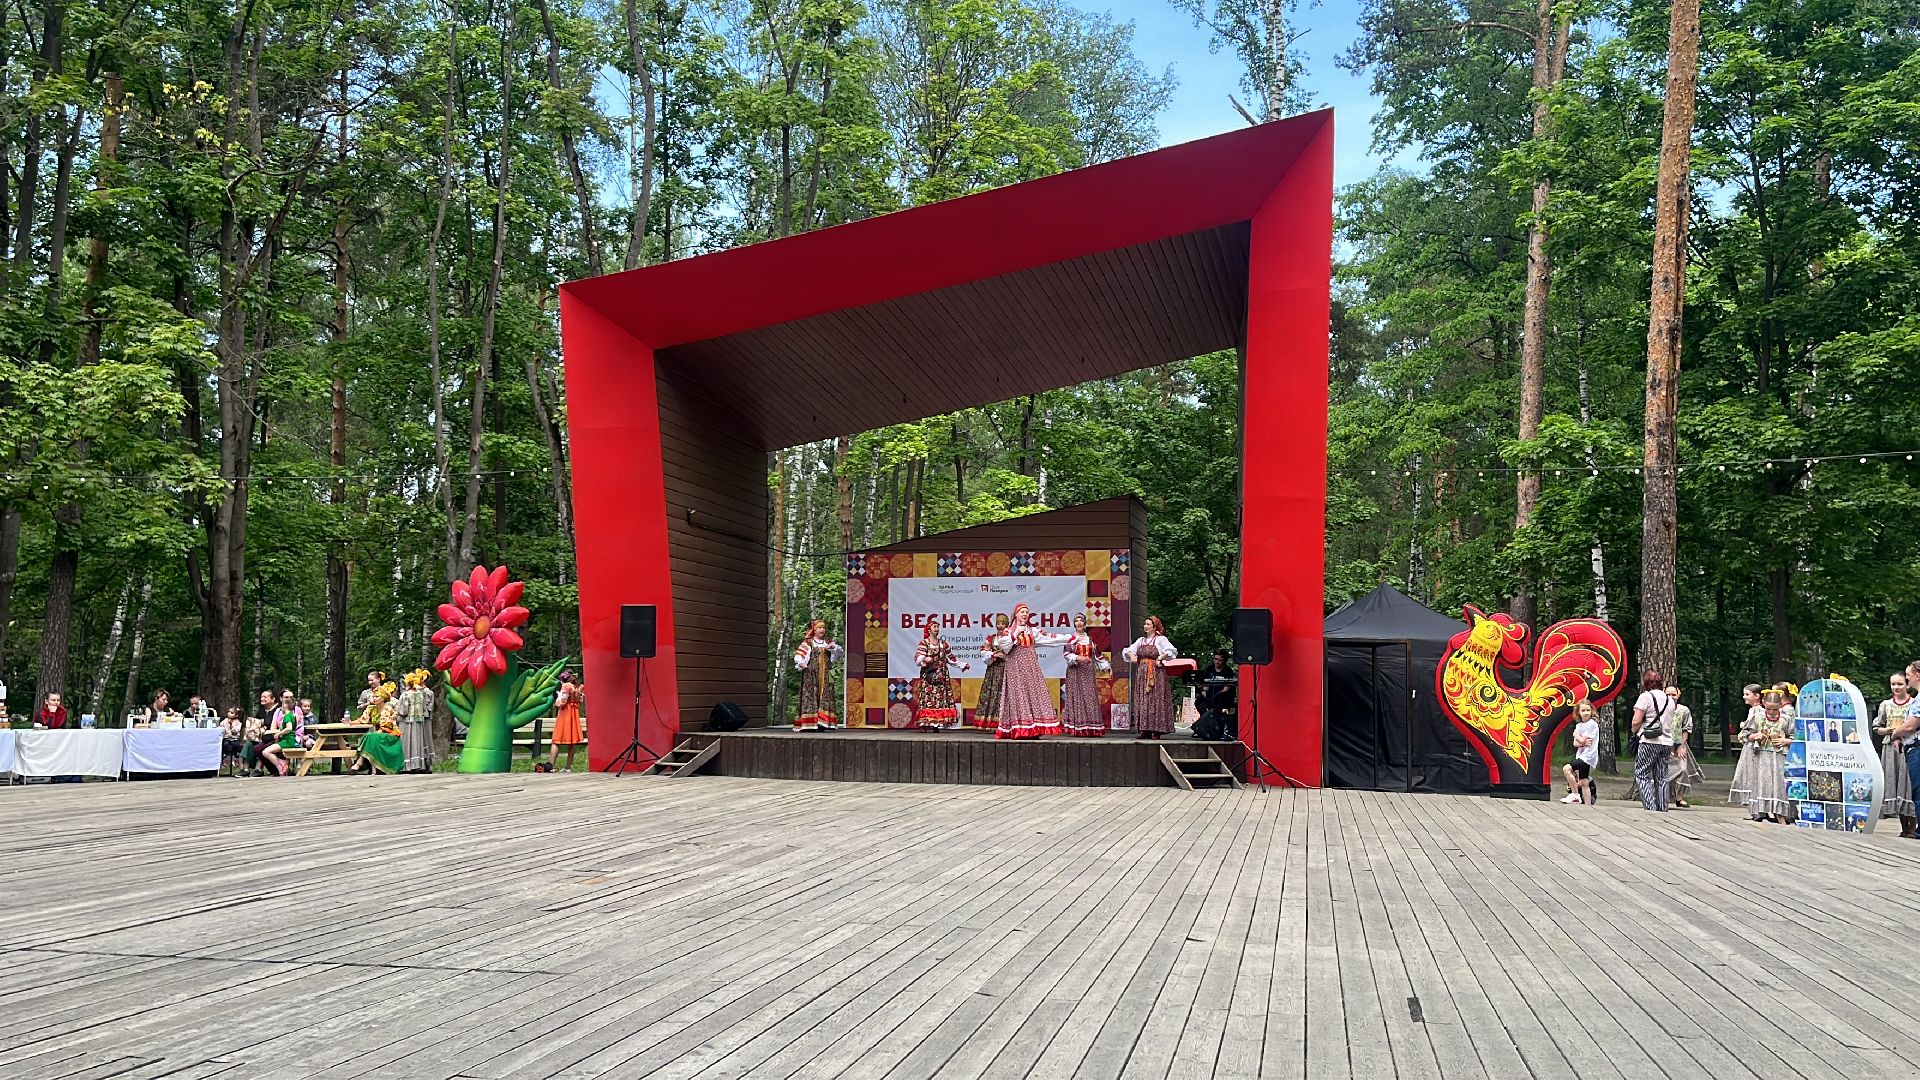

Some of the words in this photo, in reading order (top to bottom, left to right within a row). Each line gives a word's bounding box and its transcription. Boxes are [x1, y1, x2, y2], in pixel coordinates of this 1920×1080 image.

[901, 613, 1071, 628] ВЕСНА-КСНА
[940, 634, 983, 643] Открытый
[1810, 752, 1855, 761] КУЛЬТУРНЫЙ
[1826, 760, 1866, 769] БАЛАШИХИ
